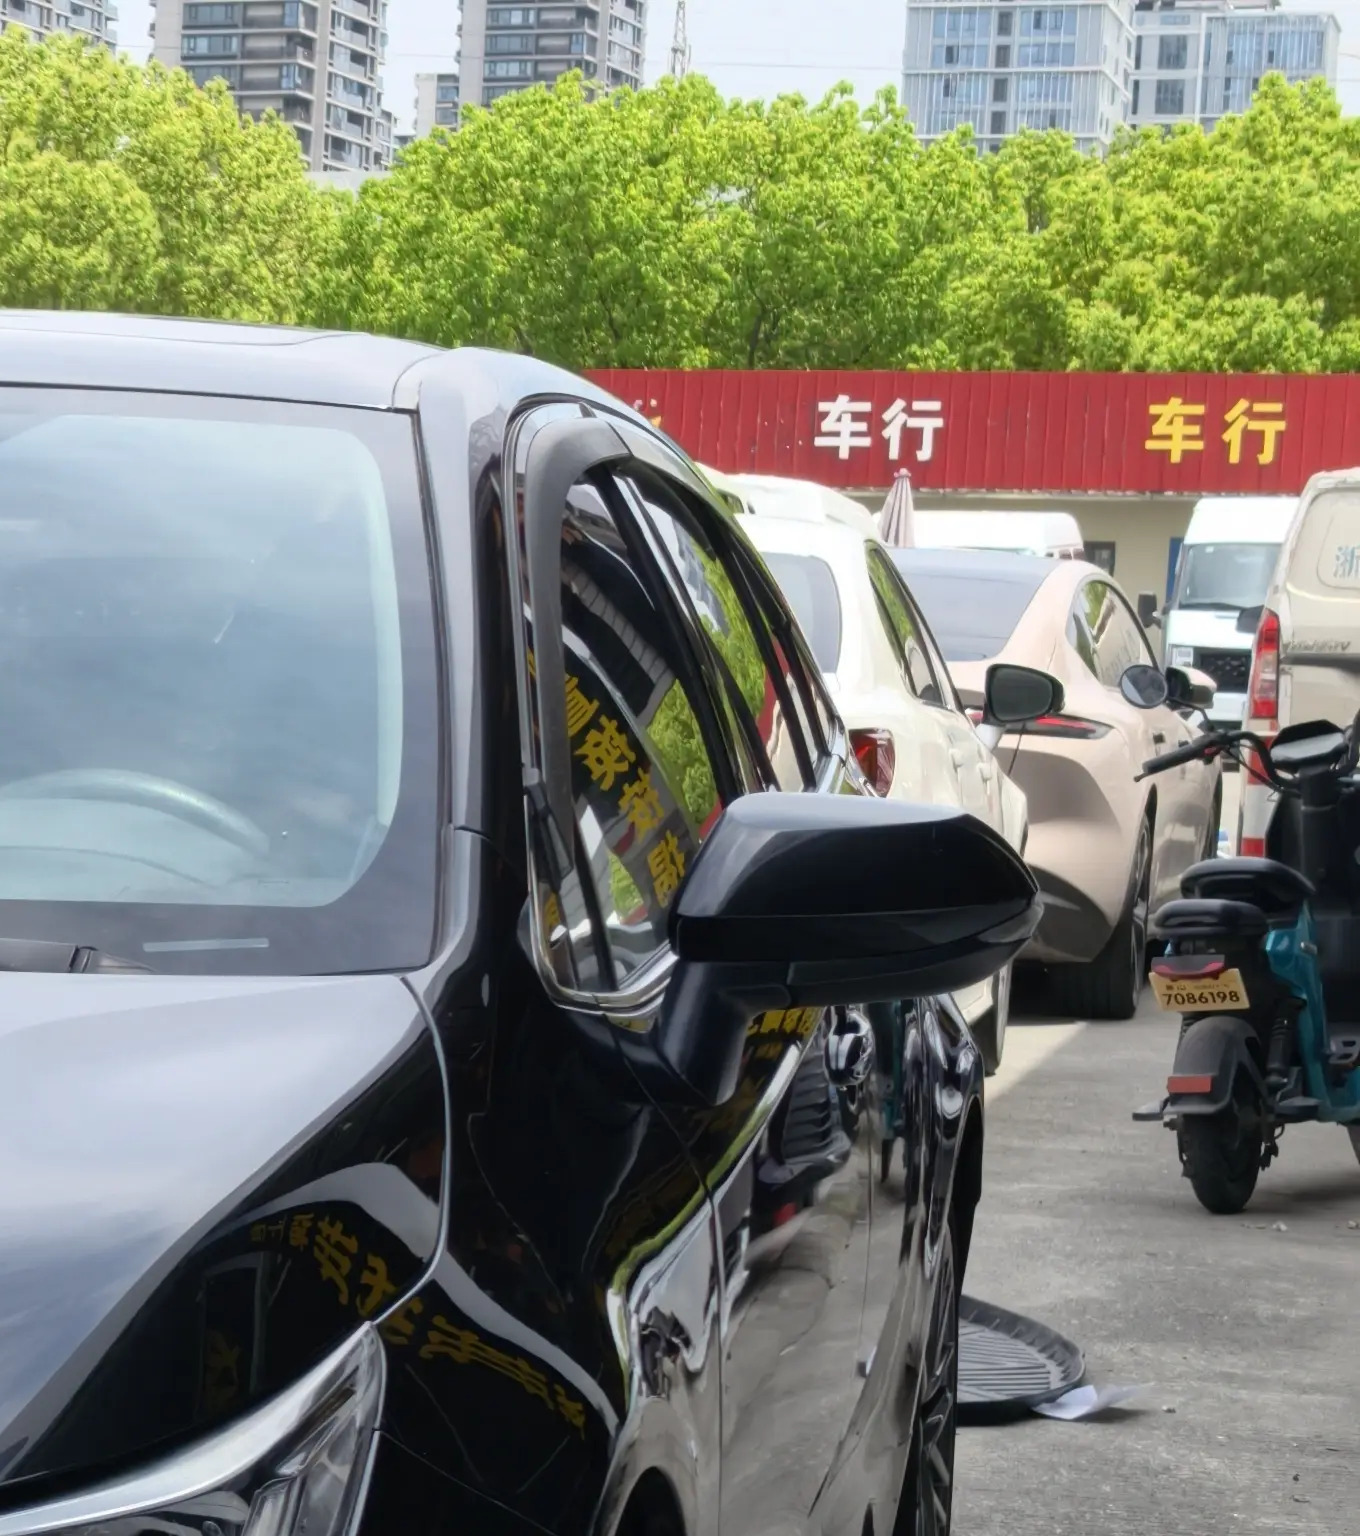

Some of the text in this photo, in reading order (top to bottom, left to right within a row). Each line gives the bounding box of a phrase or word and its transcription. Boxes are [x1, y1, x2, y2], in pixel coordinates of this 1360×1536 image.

[814, 394, 944, 461] 车行
[1145, 397, 1286, 464] 车行
[1162, 990, 1240, 1006] 7086198
